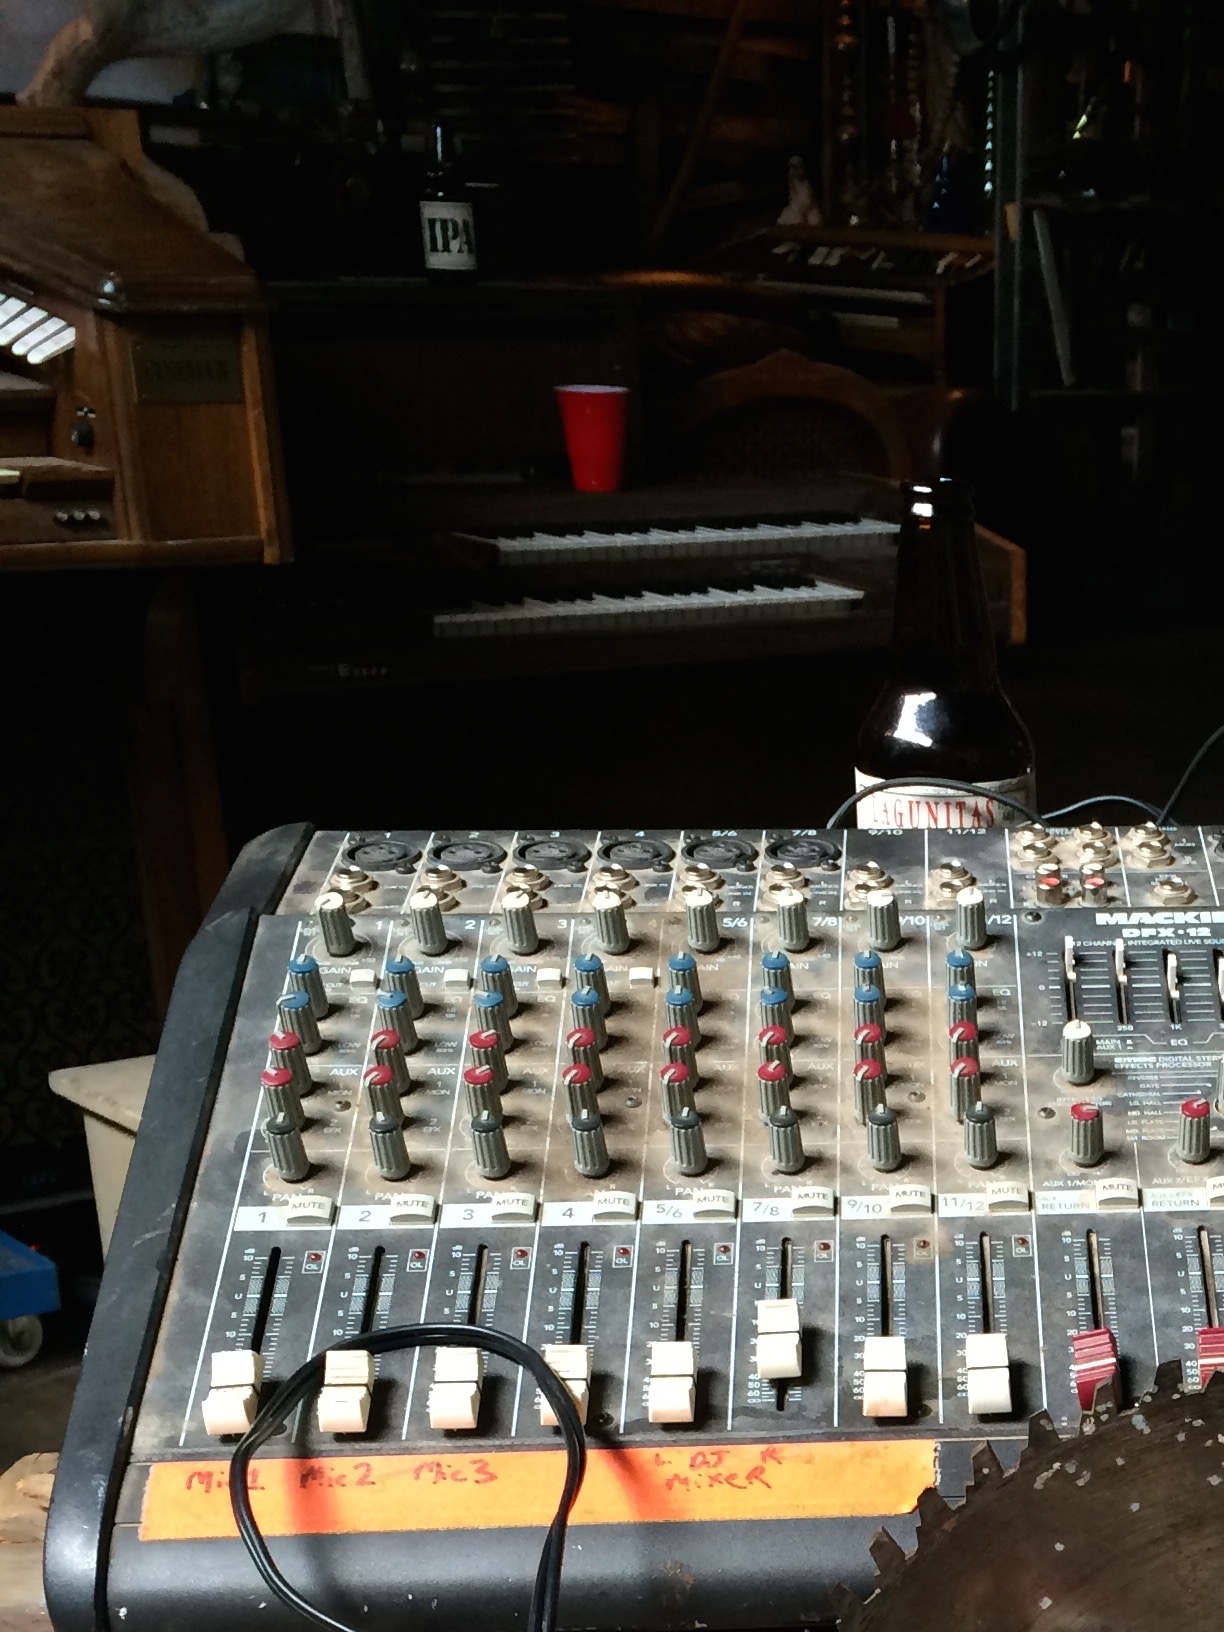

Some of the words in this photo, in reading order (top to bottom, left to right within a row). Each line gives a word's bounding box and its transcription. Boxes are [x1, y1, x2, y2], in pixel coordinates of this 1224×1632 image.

[428, 218, 475, 254] IPA
[872, 795, 994, 828] LAGUNITAS
[375, 921, 383, 930] 1
[464, 920, 476, 929] 2
[557, 920, 567, 929] 3
[723, 918, 748, 928] 5/6
[812, 917, 838, 927] 7/8
[1170, 1038, 1188, 1046] EQ
[992, 1059, 1018, 1068] AUX
[329, 1067, 358, 1077] AUX
[426, 1067, 456, 1076] AUX
[991, 1187, 1022, 1195] MUTE
[1102, 1184, 1132, 1192] MUTE
[798, 1192, 828, 1201] MUTE
[895, 1189, 925, 1198] MUTE
[496, 1198, 529, 1207] MUTE
[598, 1197, 630, 1206] MUTE
[697, 1195, 728, 1203] MUTE
[1151, 1199, 1200, 1207] RETURN
[292, 1201, 325, 1210] MUTE
[396, 1199, 429, 1209] MUTE
[753, 1201, 779, 1216] 7/8
[847, 1199, 882, 1214] 9/10
[943, 1198, 984, 1212] 11/12
[1041, 1202, 1090, 1210] RETURN
[463, 1208, 474, 1221] 3
[562, 1208, 574, 1218] 4
[656, 1204, 682, 1218] 5/6
[258, 1212, 267, 1223] 1
[358, 1210, 371, 1222] 2
